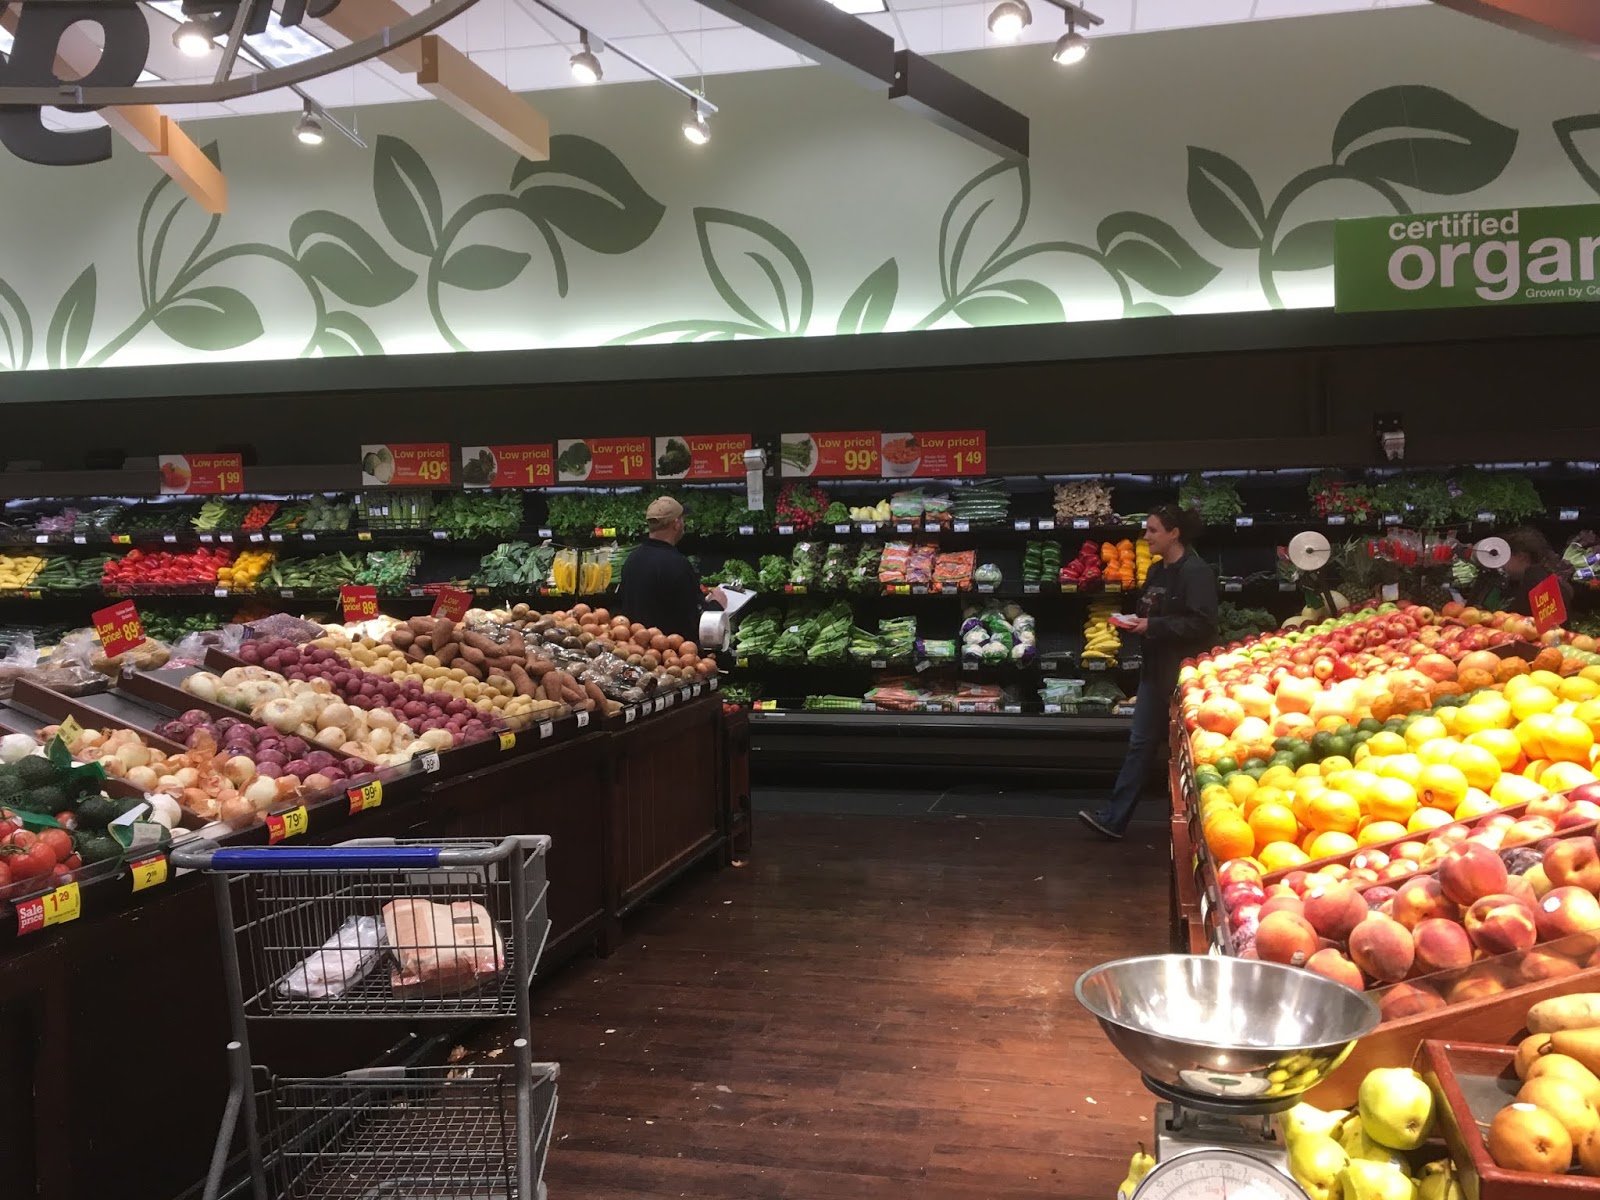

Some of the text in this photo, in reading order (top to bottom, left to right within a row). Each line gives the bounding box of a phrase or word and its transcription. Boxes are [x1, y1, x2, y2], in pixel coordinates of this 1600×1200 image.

[1388, 210, 1519, 240] certified
[1525, 287, 1565, 298] Grown
[1568, 286, 1583, 298] by
[592, 442, 645, 454] Low price!
[691, 440, 746, 452] Low price!
[818, 436, 875, 448] Low price!
[922, 436, 979, 448] Low price!
[394, 449, 444, 459] Low price!
[500, 449, 549, 460] Low price!
[192, 458, 239, 468] Low price!
[342, 595, 356, 603] Low
[444, 594, 458, 605] Low
[1534, 591, 1549, 608] Low
[97, 622, 114, 634] Low
[102, 628, 122, 647] price!
[20, 904, 43, 919] Sale
[21, 914, 43, 929] price
